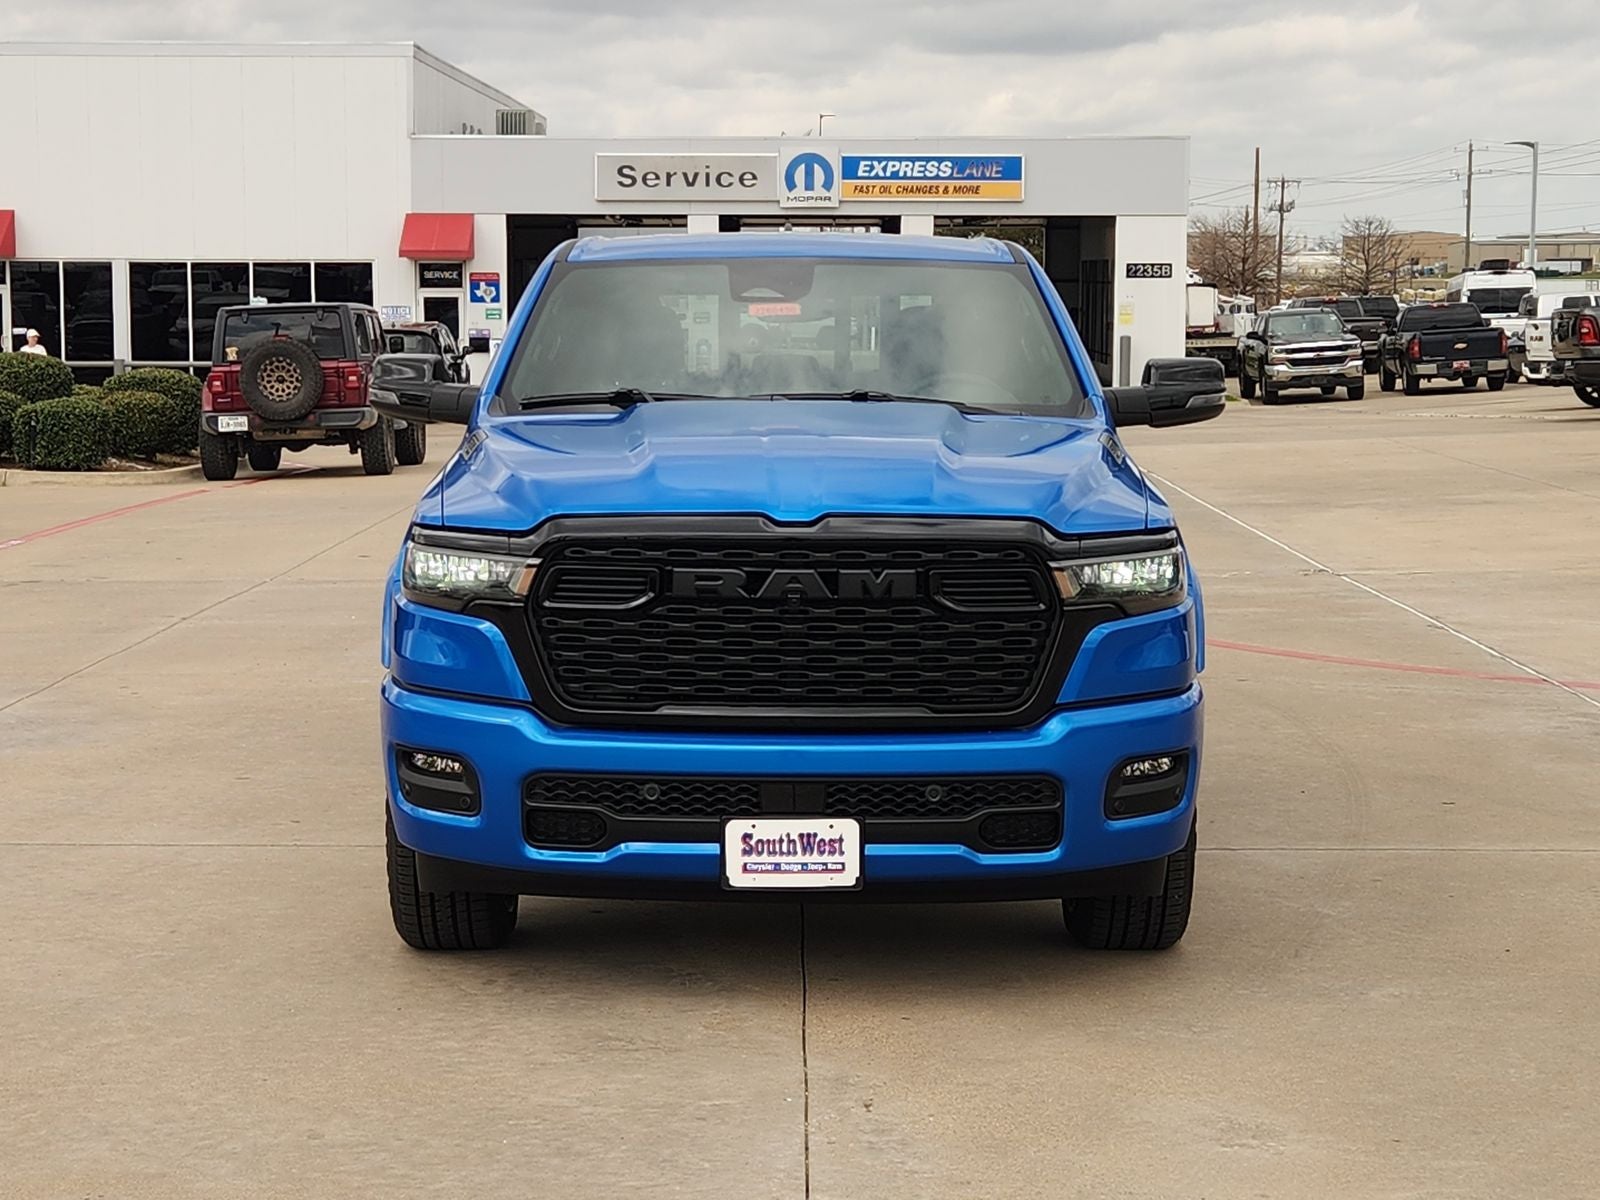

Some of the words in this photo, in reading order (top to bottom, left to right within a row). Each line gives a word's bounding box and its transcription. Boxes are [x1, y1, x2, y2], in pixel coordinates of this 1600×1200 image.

[616, 164, 759, 188] Service
[853, 184, 877, 195] FAST
[879, 184, 893, 195] OIL
[895, 185, 940, 195] CHANGES
[942, 185, 950, 195] &
[952, 185, 982, 195] MORE
[423, 270, 459, 279] SERVICE
[1127, 265, 1171, 277] 2235B
[672, 568, 916, 599] RAM
